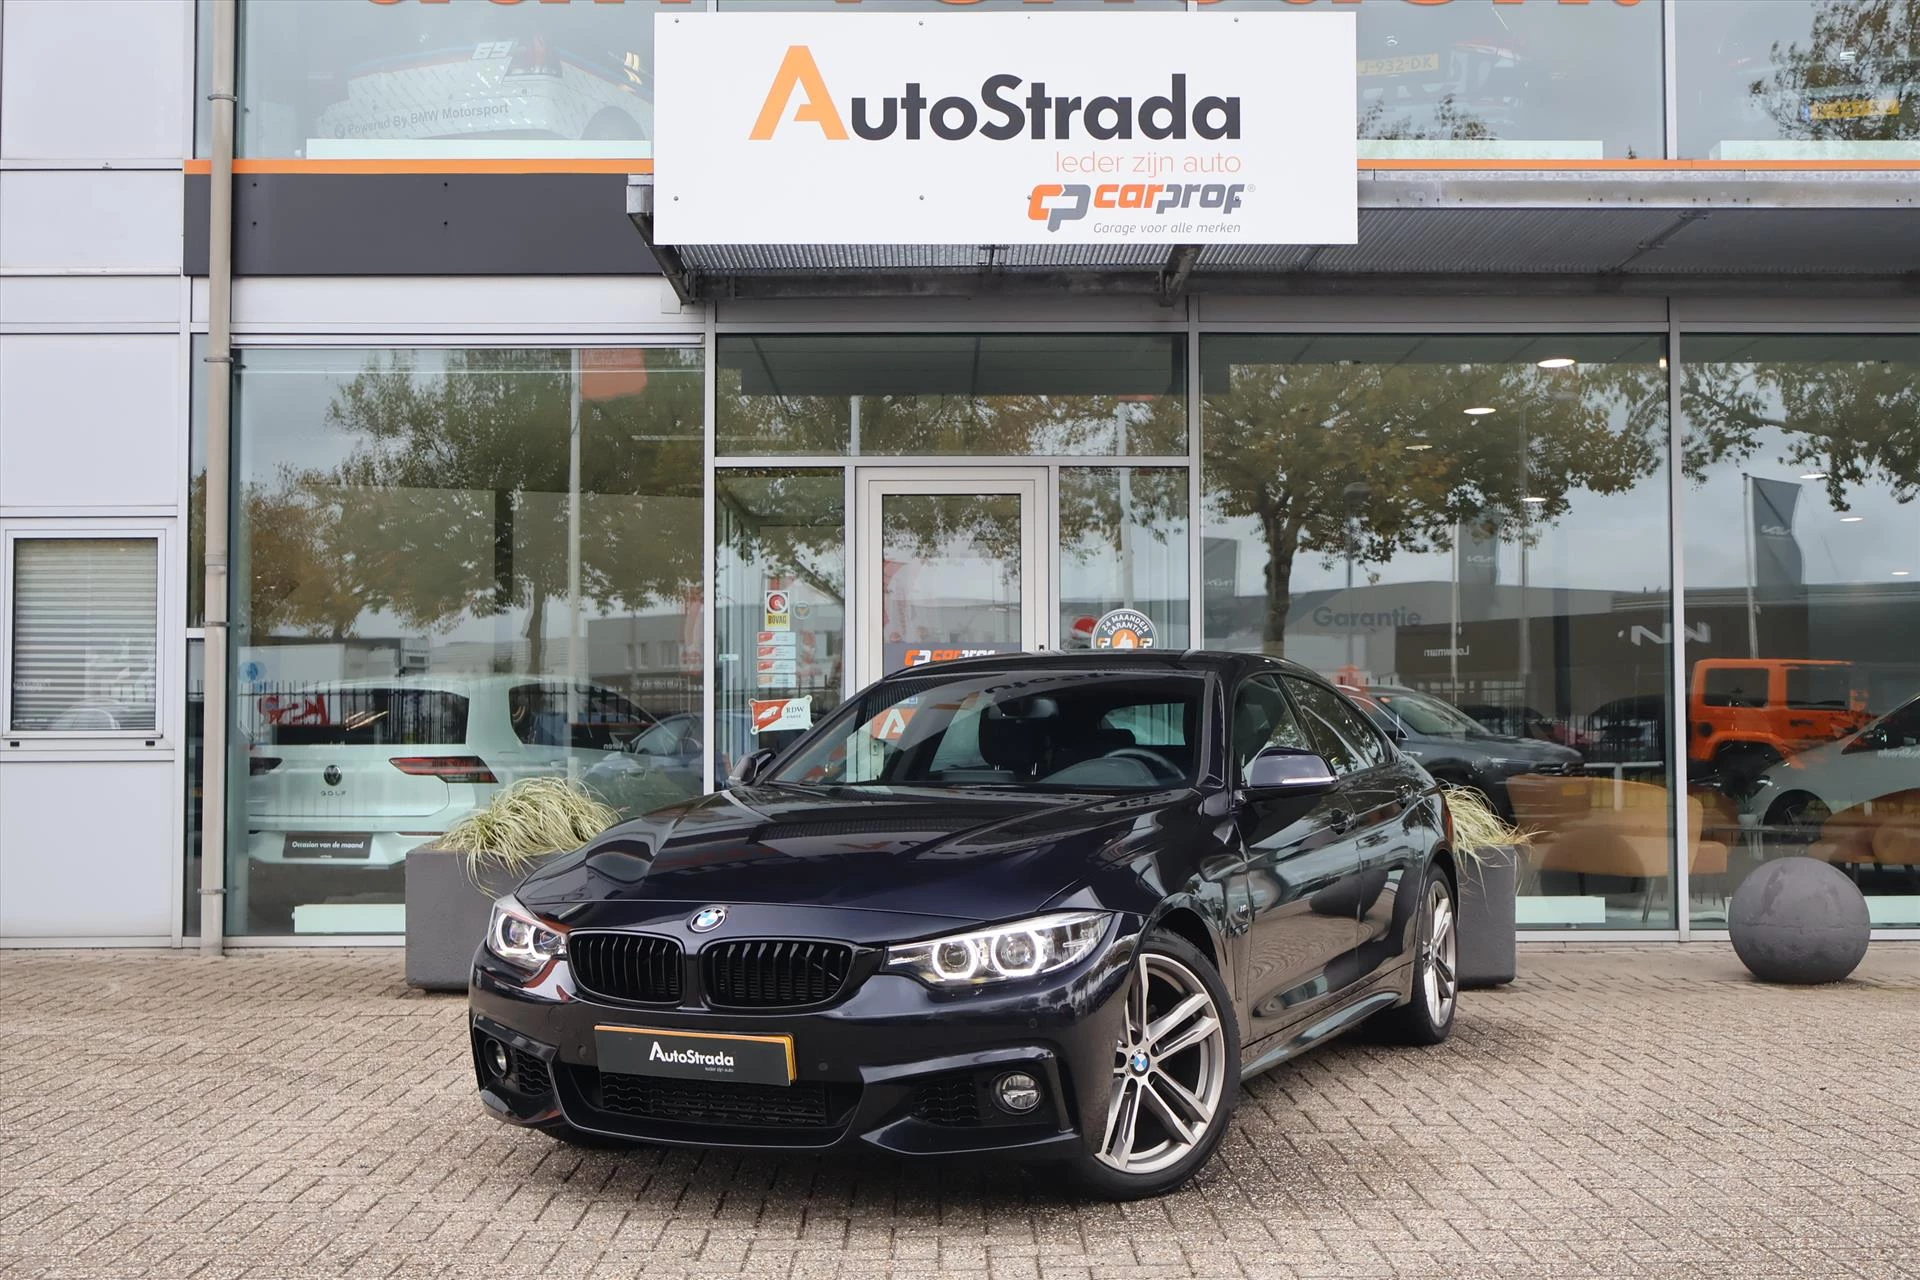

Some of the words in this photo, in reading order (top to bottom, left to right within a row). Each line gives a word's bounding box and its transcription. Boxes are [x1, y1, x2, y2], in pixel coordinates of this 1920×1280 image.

[748, 45, 1241, 141] AutoStrada
[393, 114, 409, 130] By
[410, 110, 438, 124] BMW
[442, 103, 509, 121] Motorsport
[1056, 151, 1124, 173] Ieder
[1132, 152, 1175, 178] zijn
[1183, 153, 1241, 173] auto
[1093, 222, 1137, 235] Garage
[1139, 225, 1169, 234] voor
[1171, 222, 1194, 233] alle
[1196, 222, 1241, 233] merken
[1102, 621, 1112, 632] 24
[1111, 614, 1150, 633] MAANDEN
[1312, 606, 1423, 628] Garantie
[1107, 622, 1144, 637] GARANTIE
[785, 705, 806, 714] RDW
[291, 840, 319, 849] Occasion
[332, 841, 340, 849] de
[340, 840, 364, 849] maand
[649, 1041, 734, 1066] AutoStrada
